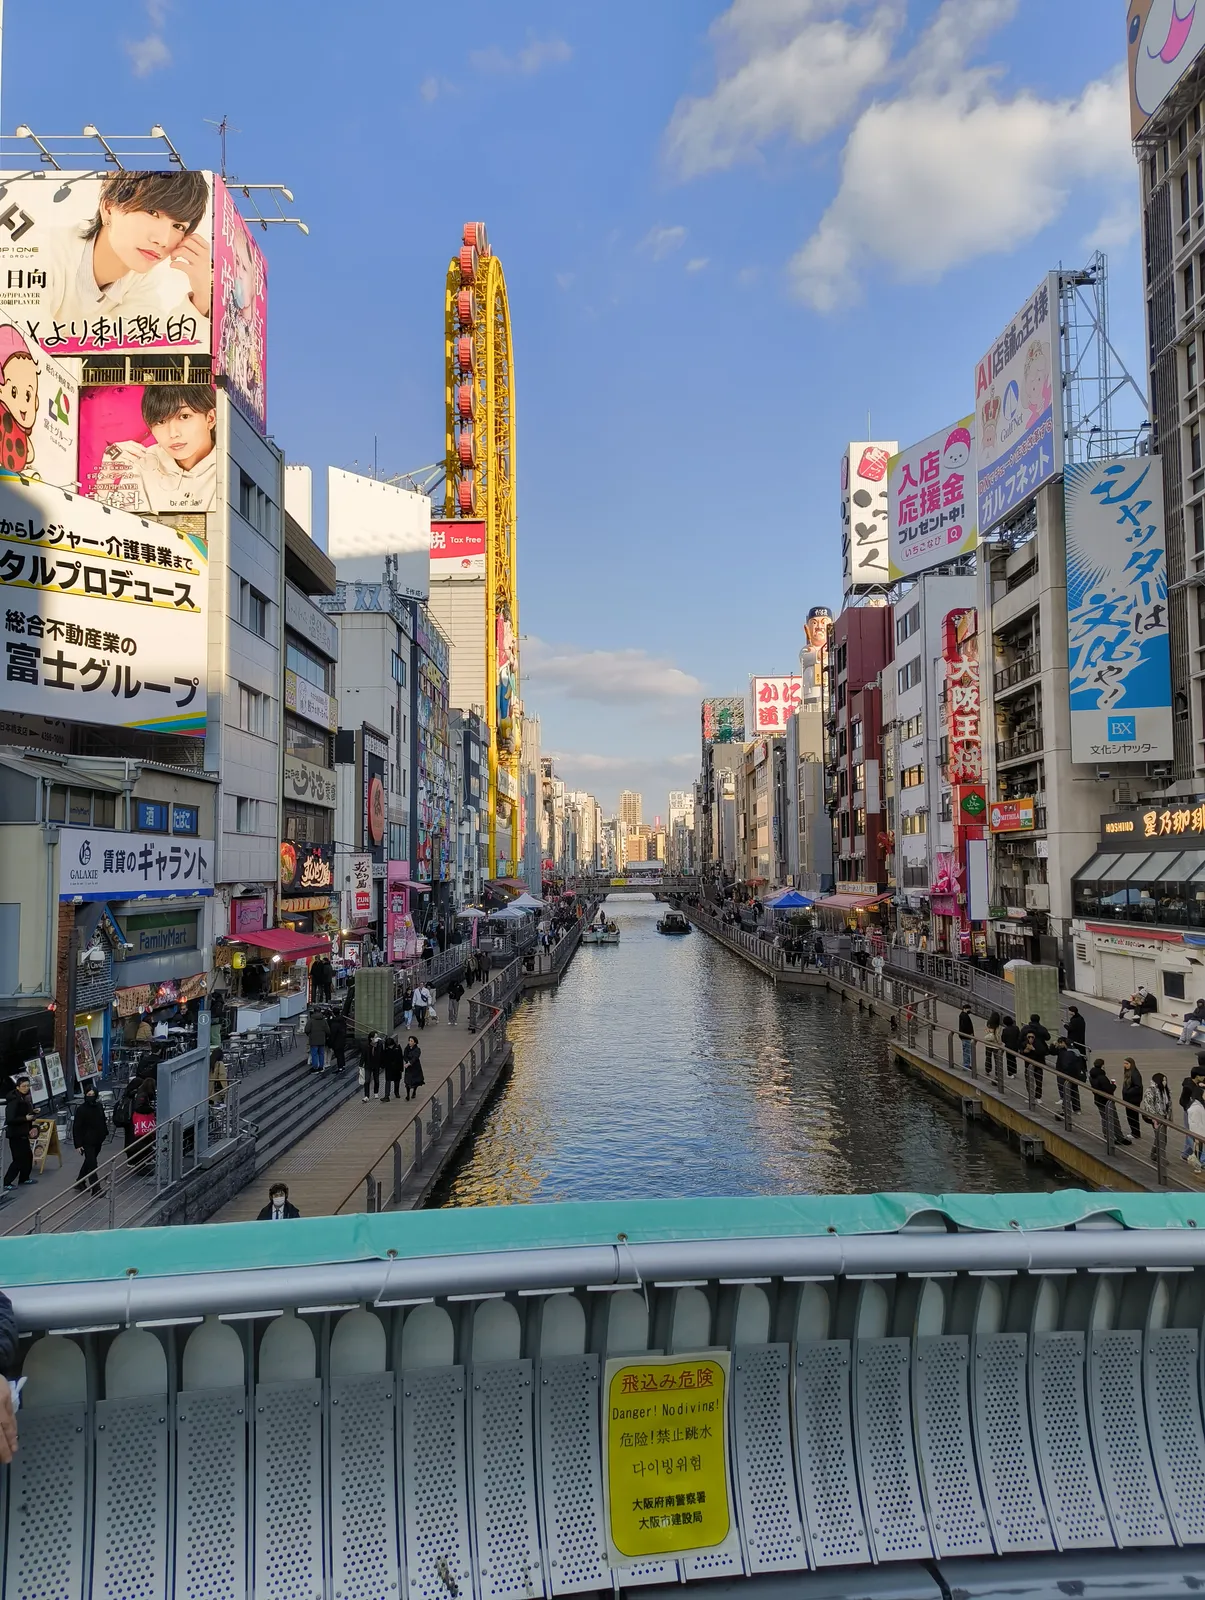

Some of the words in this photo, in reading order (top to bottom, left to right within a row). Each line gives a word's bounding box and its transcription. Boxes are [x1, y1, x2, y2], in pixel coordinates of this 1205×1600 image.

[8, 269, 47, 289] 日向
[15, 314, 197, 347] Xより刺激的
[976, 285, 1049, 400] AI店舗の王様
[898, 450, 940, 496] 入店
[982, 446, 1050, 525] ガルフネット
[898, 472, 965, 528] 応援金
[898, 503, 965, 545] プレゼント中!
[430, 531, 446, 549] 税
[0, 549, 195, 609] タルプロデュース
[5, 609, 137, 656] 総合不動産業の
[6, 641, 199, 708] 富士グループ
[758, 682, 801, 703] かに
[949, 655, 983, 779] 大阪王将
[1111, 722, 1133, 735] BX
[173, 810, 191, 829] たばこ
[1106, 821, 1134, 833] HOSHINO
[103, 842, 208, 881] 賃貸のギャラント
[140, 928, 186, 950] FamilyMart
[621, 1367, 714, 1393] 飛込み危険
[612, 1405, 657, 1420] Danger!
[620, 1424, 713, 1448] 危险!禁止跳水
[632, 1454, 702, 1477] 다이빙위험
[632, 1490, 706, 1511] 大阪府南警察署
[638, 1511, 703, 1530] 大阪市建設局
